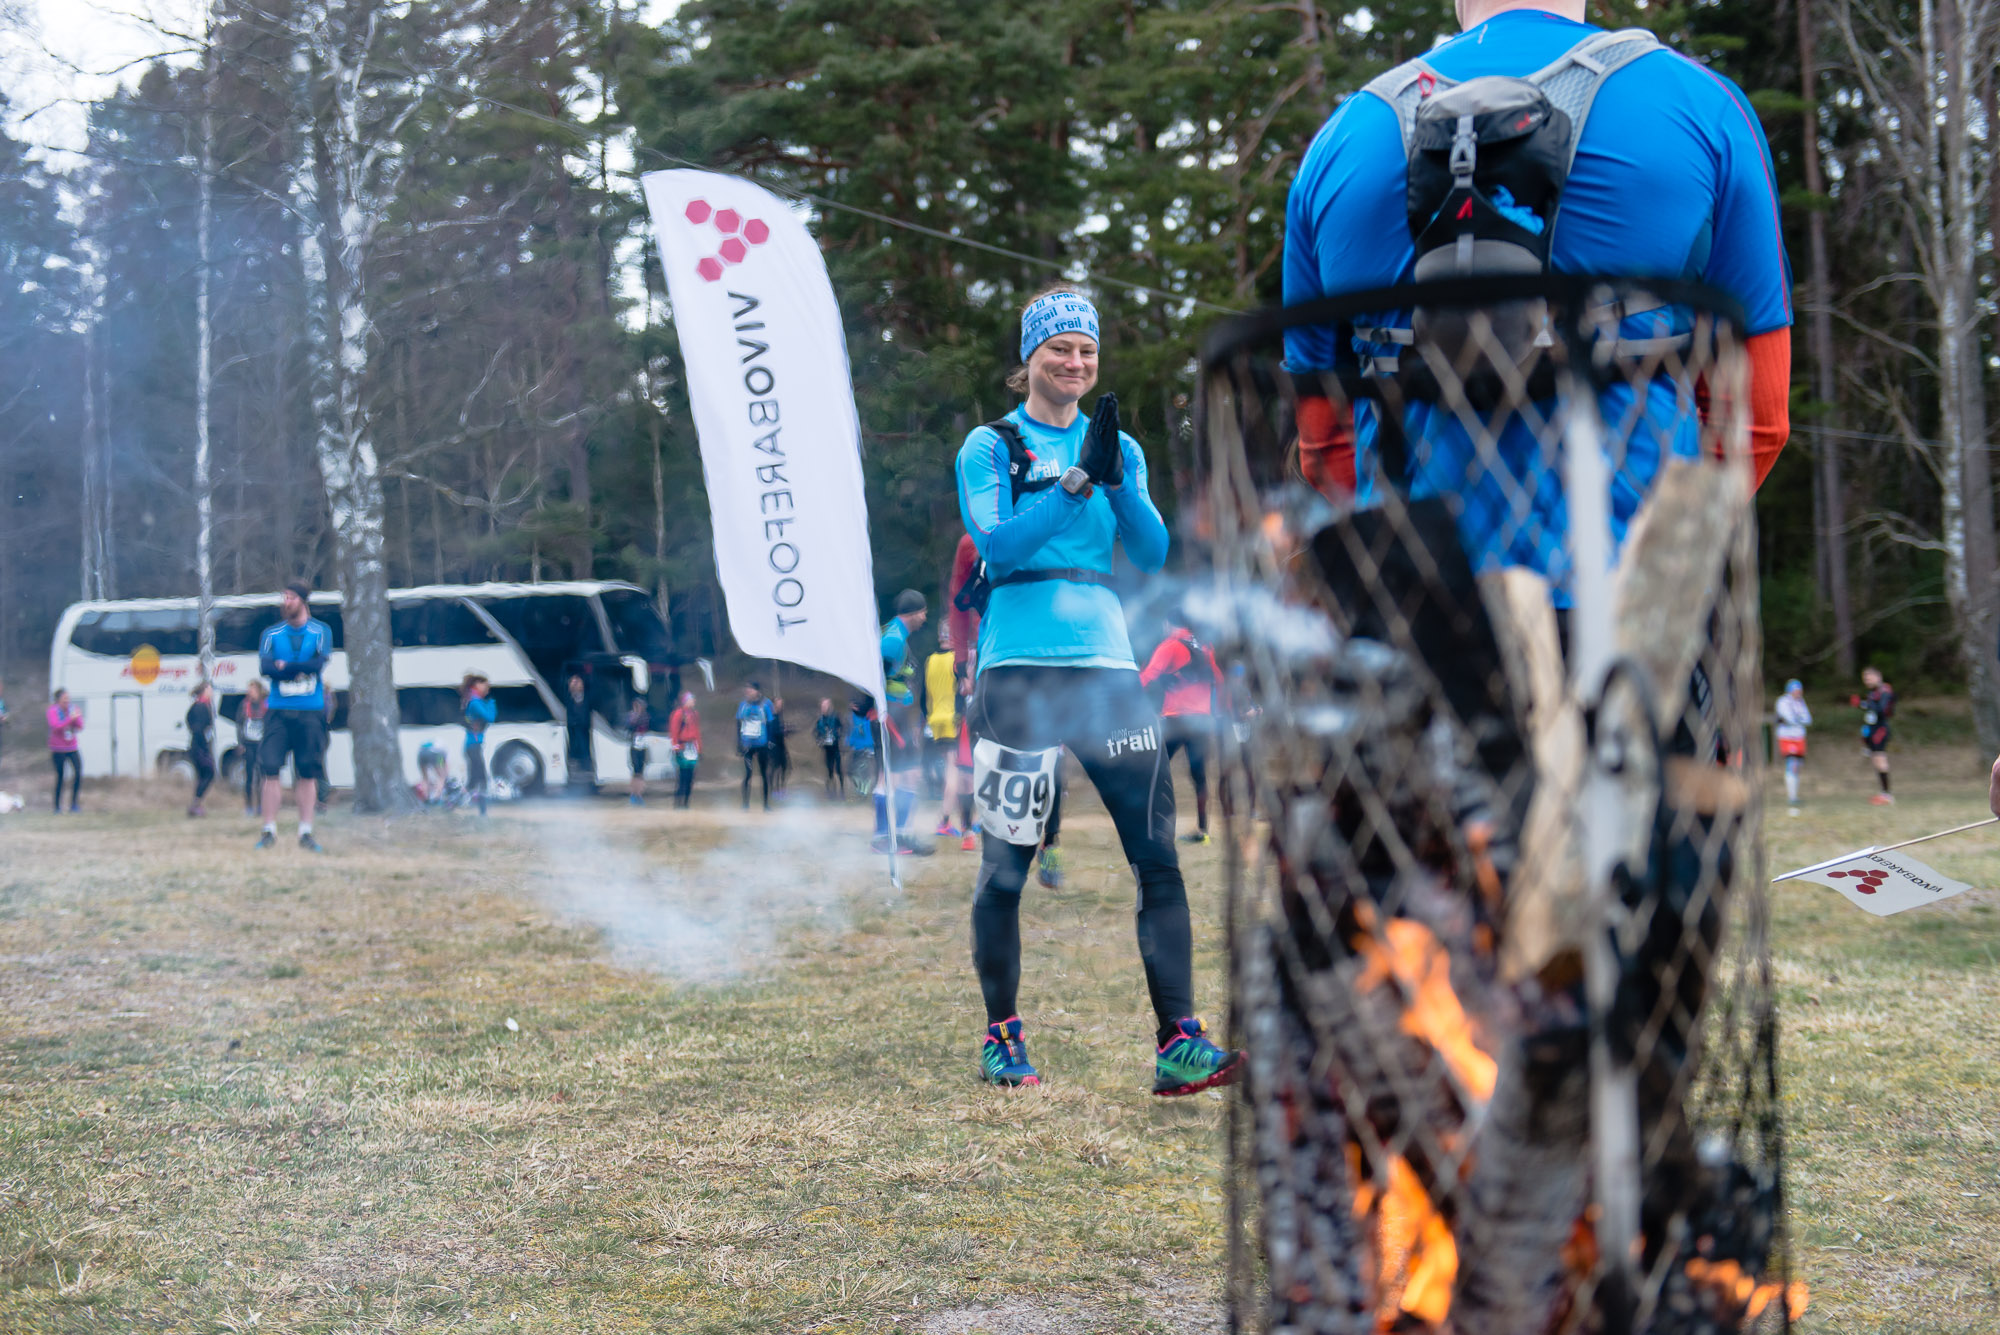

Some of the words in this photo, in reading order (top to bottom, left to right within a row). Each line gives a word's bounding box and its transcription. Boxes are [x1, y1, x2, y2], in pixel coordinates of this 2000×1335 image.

[1055, 316, 1082, 332] trail
[1107, 725, 1157, 759] trail
[978, 769, 1050, 820] 499
